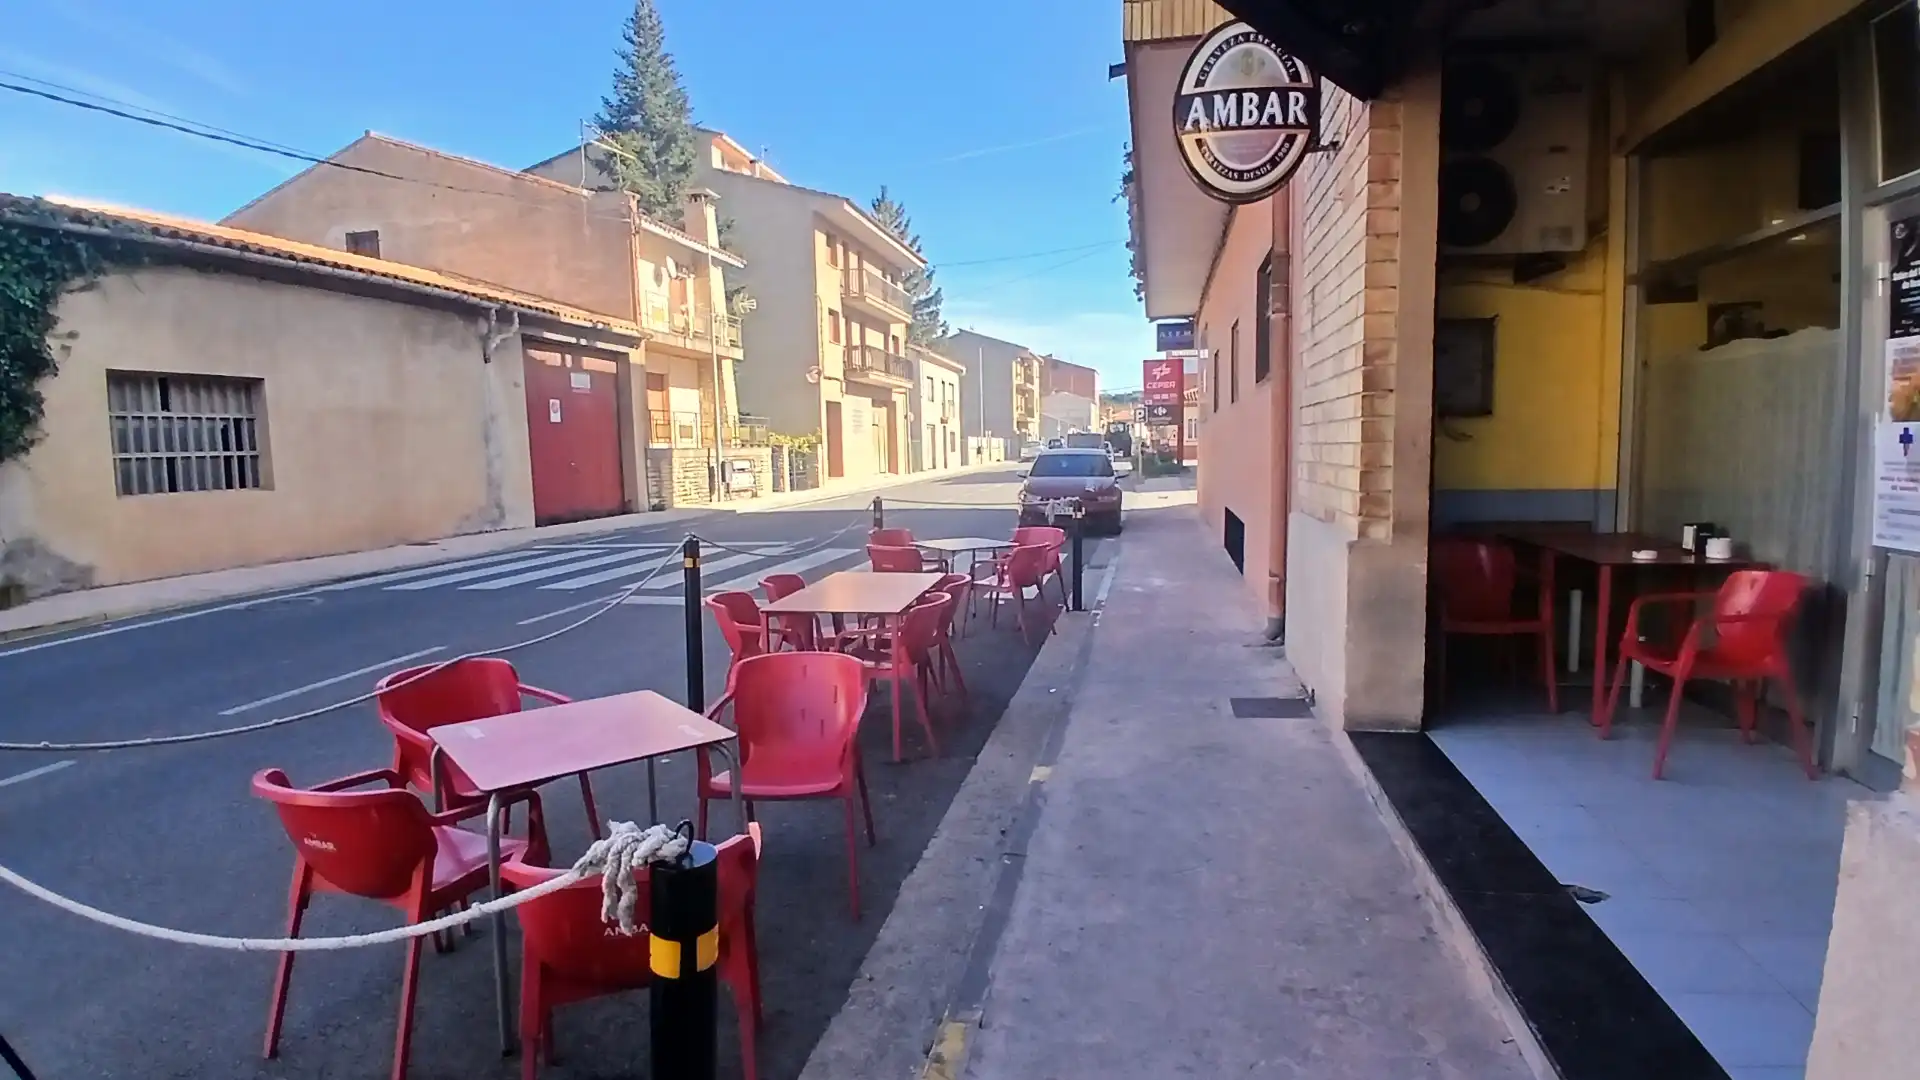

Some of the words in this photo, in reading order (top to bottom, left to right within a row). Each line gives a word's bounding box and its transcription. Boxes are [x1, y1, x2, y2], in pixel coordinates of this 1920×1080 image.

[1199, 34, 1245, 81] CERVEZA
[1250, 33, 1294, 76] ESPECIAL
[1185, 91, 1309, 131] AMBAR
[1201, 144, 1239, 180] CERVEZAS
[1243, 162, 1273, 180] DESDE
[1275, 142, 1291, 162] 1900
[303, 837, 337, 851] AMBAR
